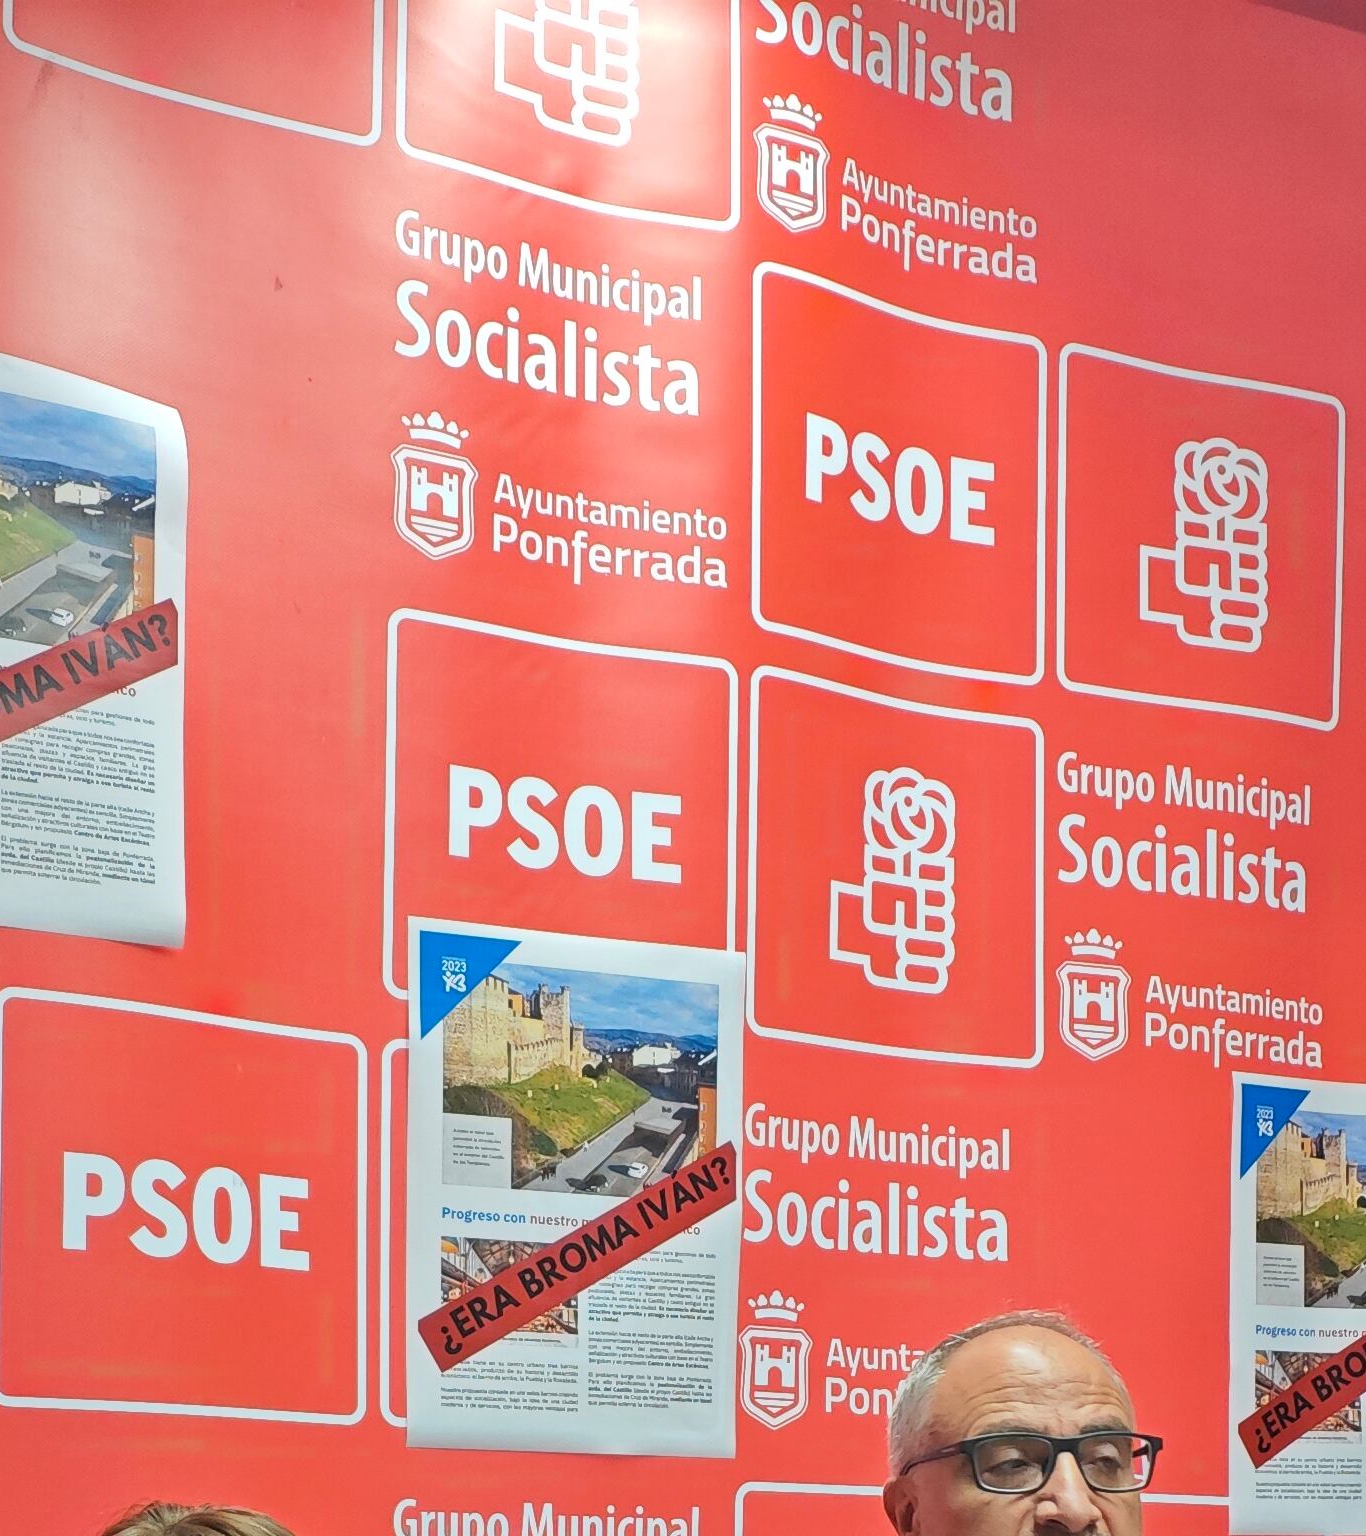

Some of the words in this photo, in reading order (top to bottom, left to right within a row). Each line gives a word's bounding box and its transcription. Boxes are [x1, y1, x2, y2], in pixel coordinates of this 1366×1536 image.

[900, 0, 1016, 35] cipal
[755, 0, 1013, 122] Socialista
[842, 157, 1037, 239] Ayuntamiento
[395, 209, 508, 284] Grupo
[518, 242, 702, 322] Municipal
[841, 194, 1038, 284] Ponferrada
[394, 279, 700, 417] Socialista
[493, 473, 728, 541] Ayuntamiento
[805, 411, 995, 547] PSOE
[492, 513, 728, 589] Ponferrada
[60, 613, 173, 685] IVÁN?
[448, 763, 682, 885] PSOE
[1056, 751, 1155, 810] Grupo
[1164, 764, 1311, 830] Municipal
[1057, 813, 1306, 913] Socialista
[442, 960, 467, 973] 2023
[1145, 975, 1323, 1026] Ayuntamiento
[1145, 1011, 1323, 1069] Ponferrada
[744, 1102, 840, 1164] Grupo
[848, 1115, 1010, 1180] Municipal
[62, 1151, 310, 1272] PSOE
[441, 1206, 500, 1223] Progreso
[503, 1212, 526, 1224] con
[530, 1213, 579, 1227] nuestro
[743, 1169, 1009, 1262] Socialista
[441, 1285, 521, 1354] ¿ERA
[517, 1215, 640, 1299] BROMA
[637, 1156, 731, 1230] IVÁN?
[1255, 1324, 1297, 1339] Progreso
[1299, 1327, 1316, 1338] con
[1318, 1327, 1358, 1338] nuestro
[1254, 1390, 1315, 1454] ¿ERA
